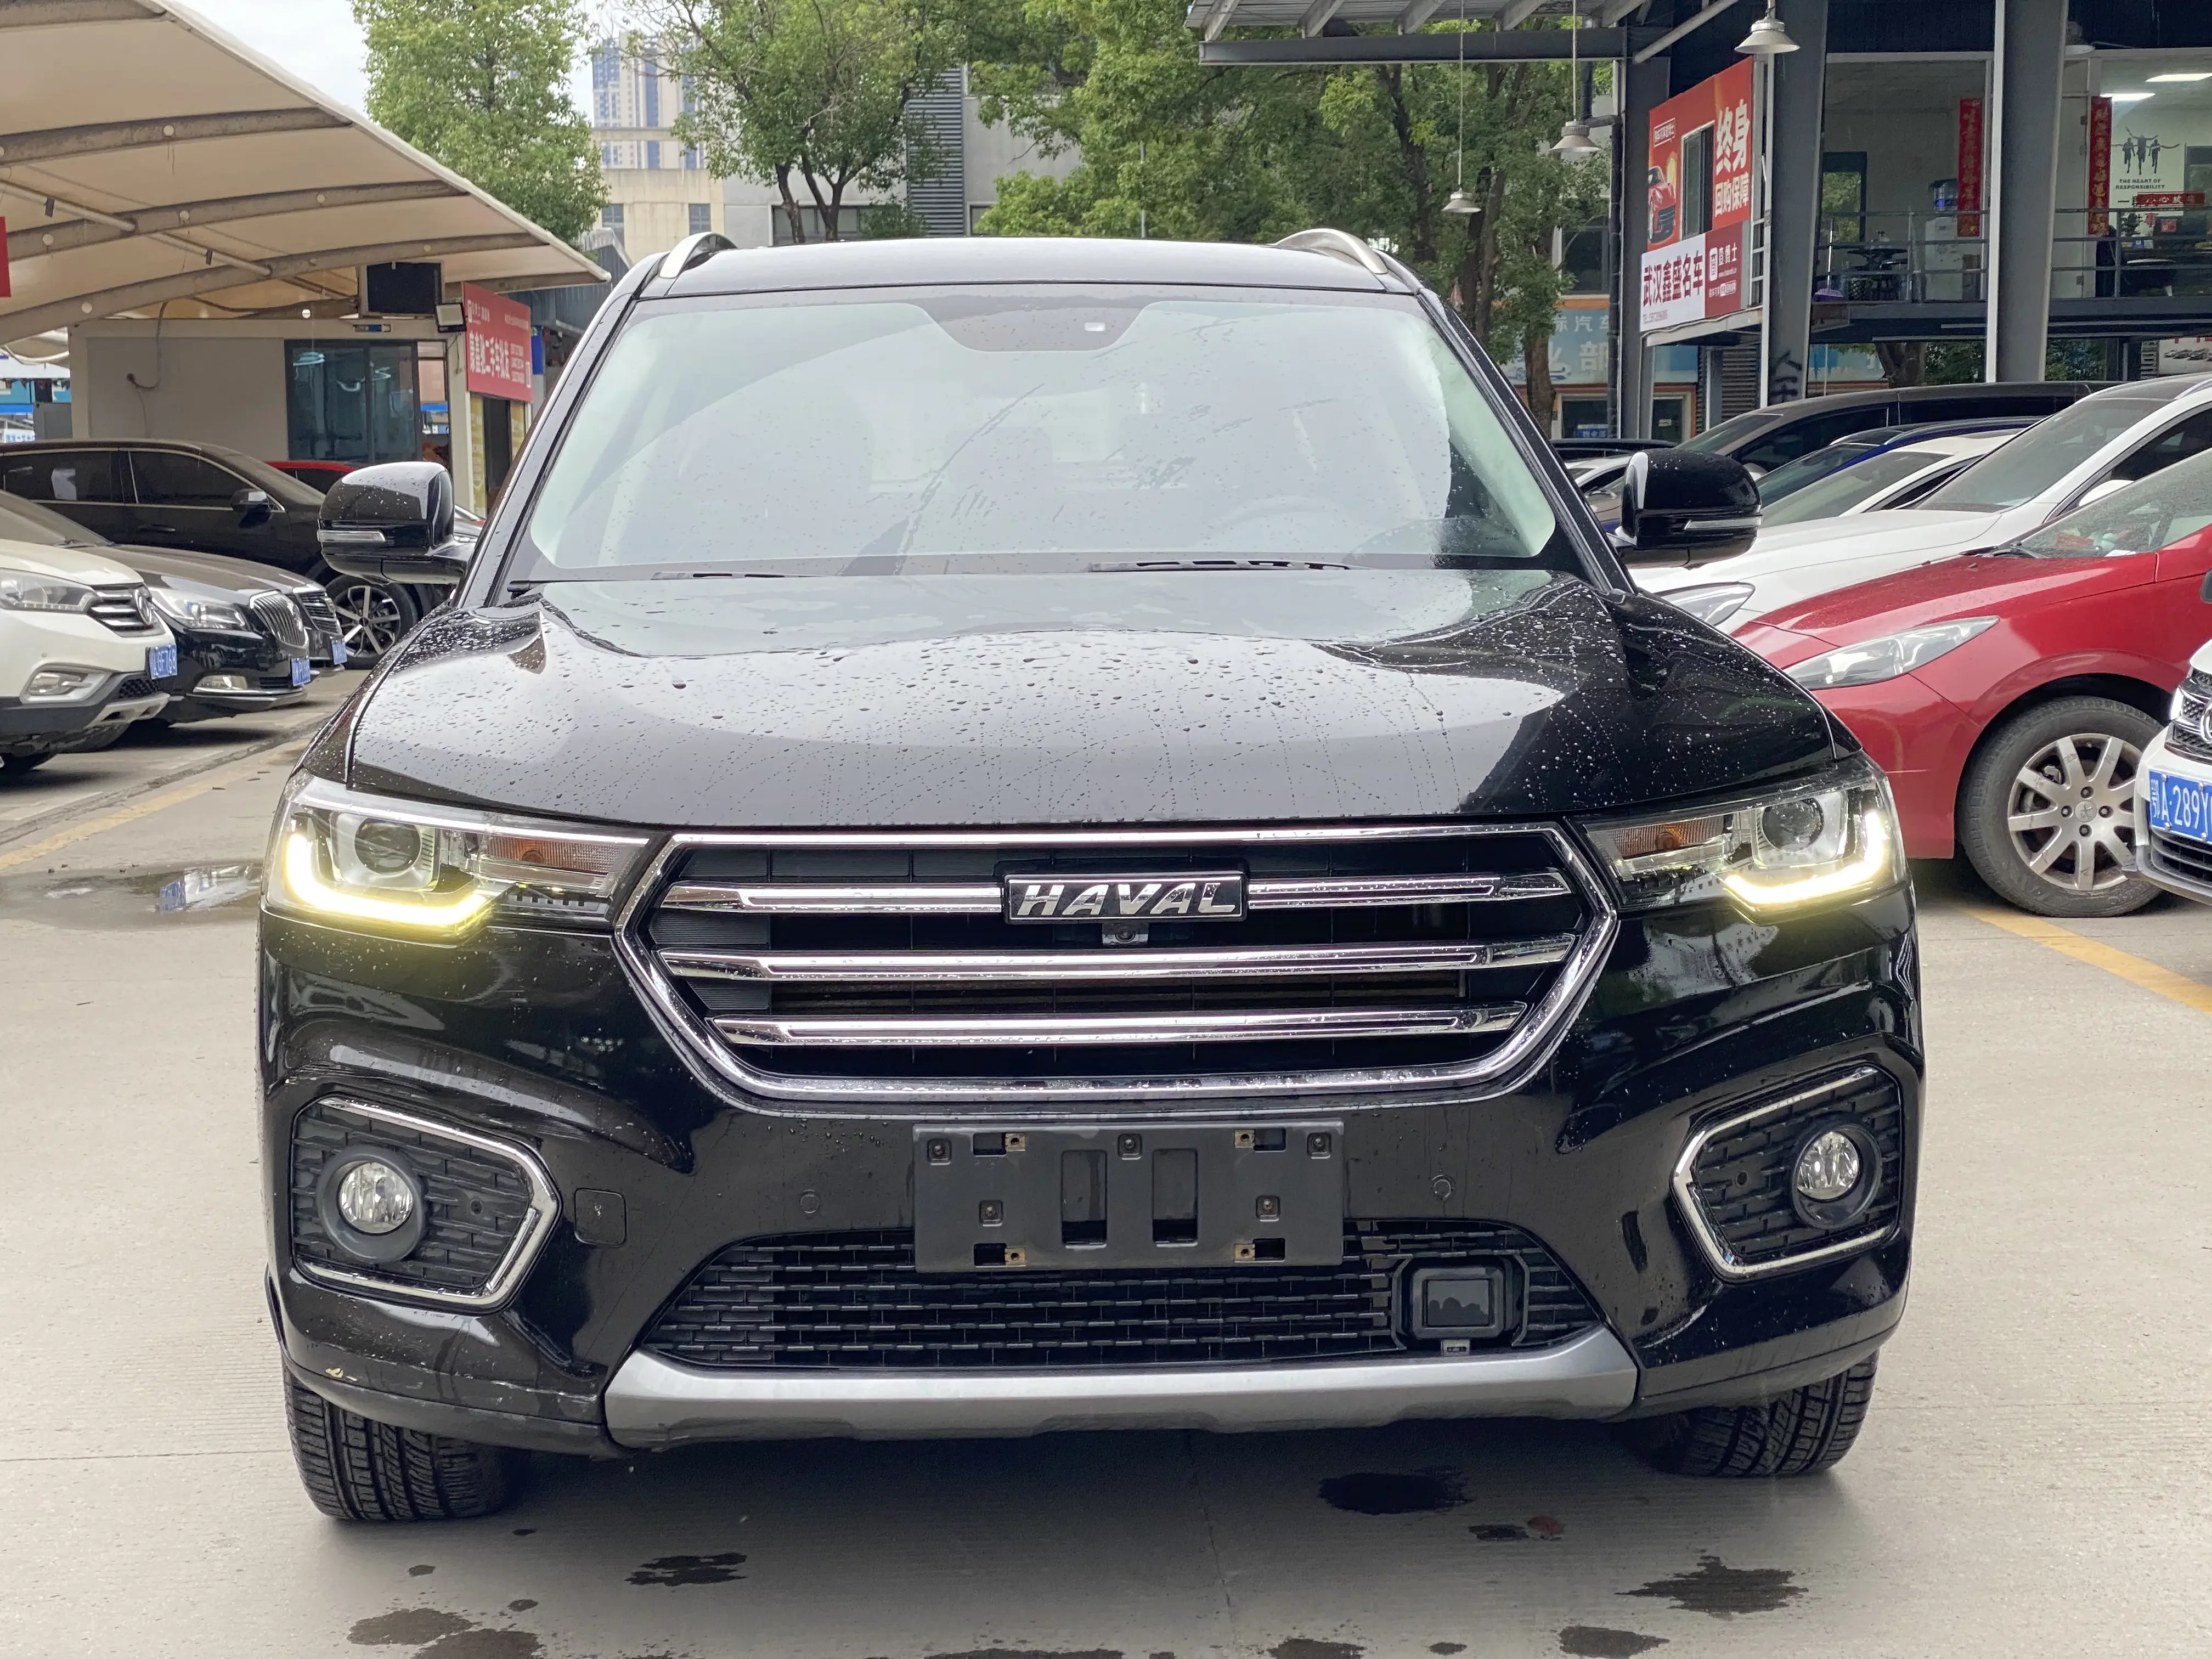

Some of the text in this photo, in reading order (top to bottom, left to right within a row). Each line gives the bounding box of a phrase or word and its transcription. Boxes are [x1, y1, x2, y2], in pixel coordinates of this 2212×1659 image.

[1716, 99, 1750, 176] 终身
[1715, 171, 1750, 217] 回购保障
[1643, 250, 1703, 307] 武汉鑫盛名车
[1017, 883, 1235, 916] HAVAL
